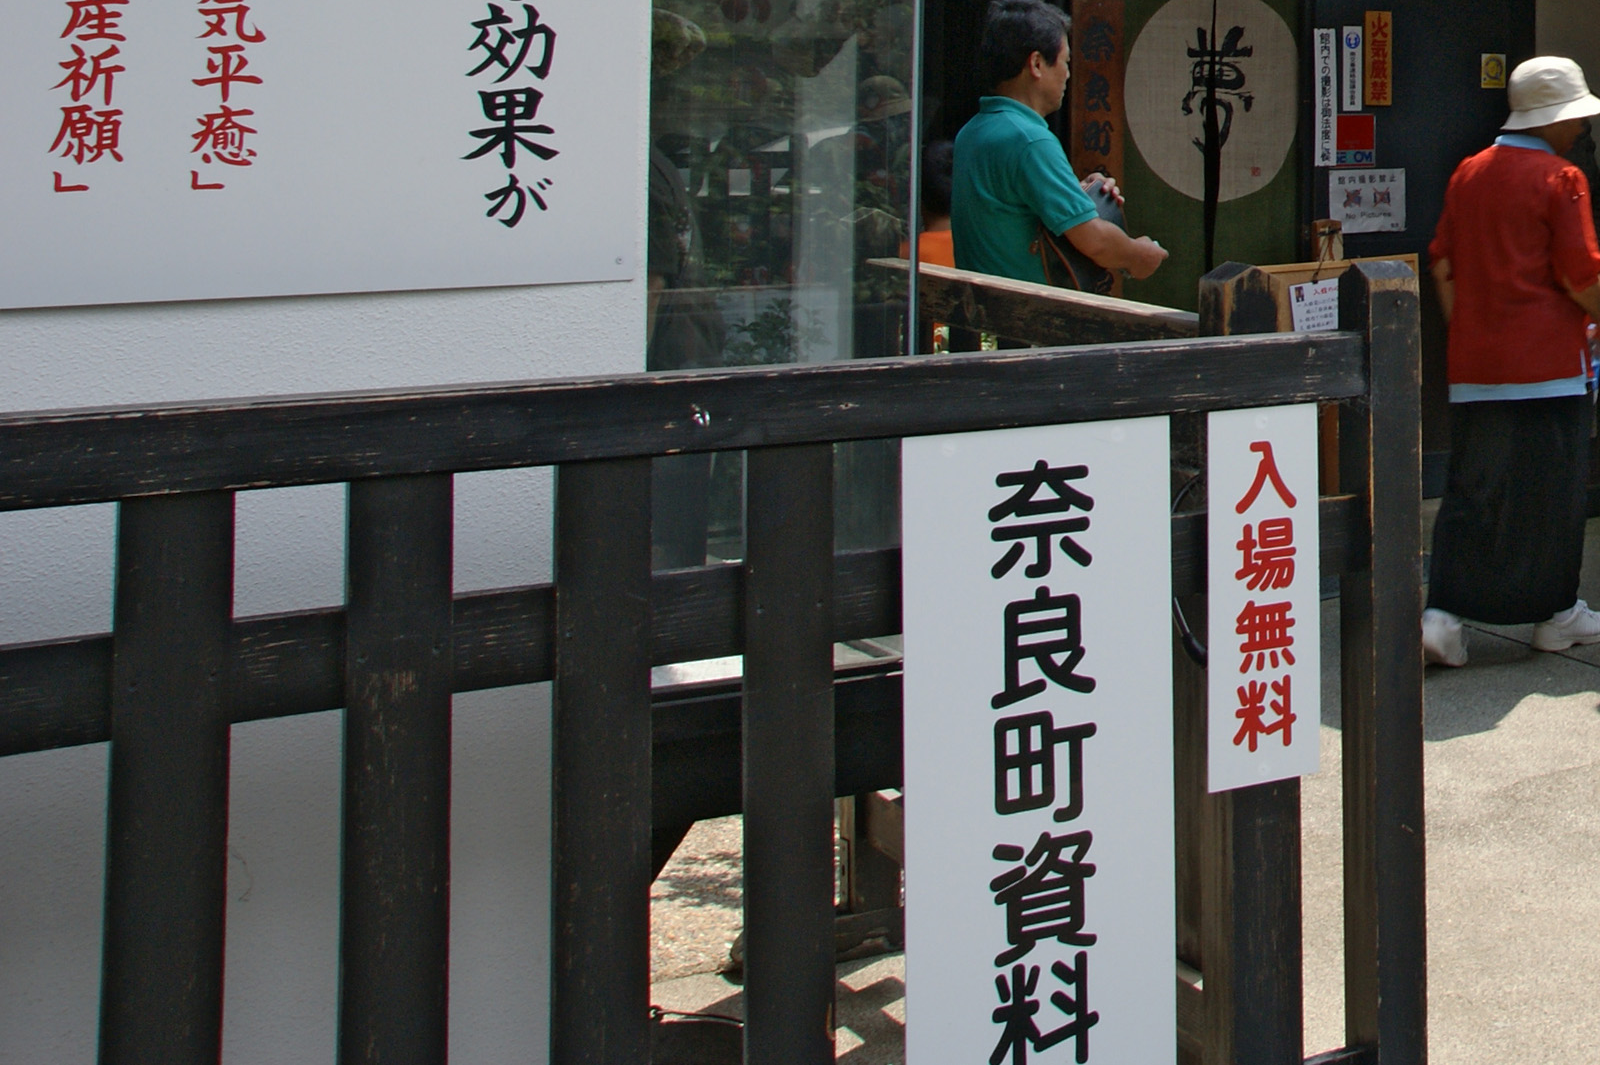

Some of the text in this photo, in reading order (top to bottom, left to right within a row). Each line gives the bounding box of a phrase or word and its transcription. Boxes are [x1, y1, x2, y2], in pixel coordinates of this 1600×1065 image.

[1370, 12, 1388, 101] 火気厳禁
[1345, 212, 1356, 220] No
[1233, 440, 1297, 753] 入場無料
[986, 459, 1099, 1065] 奈良町資料
